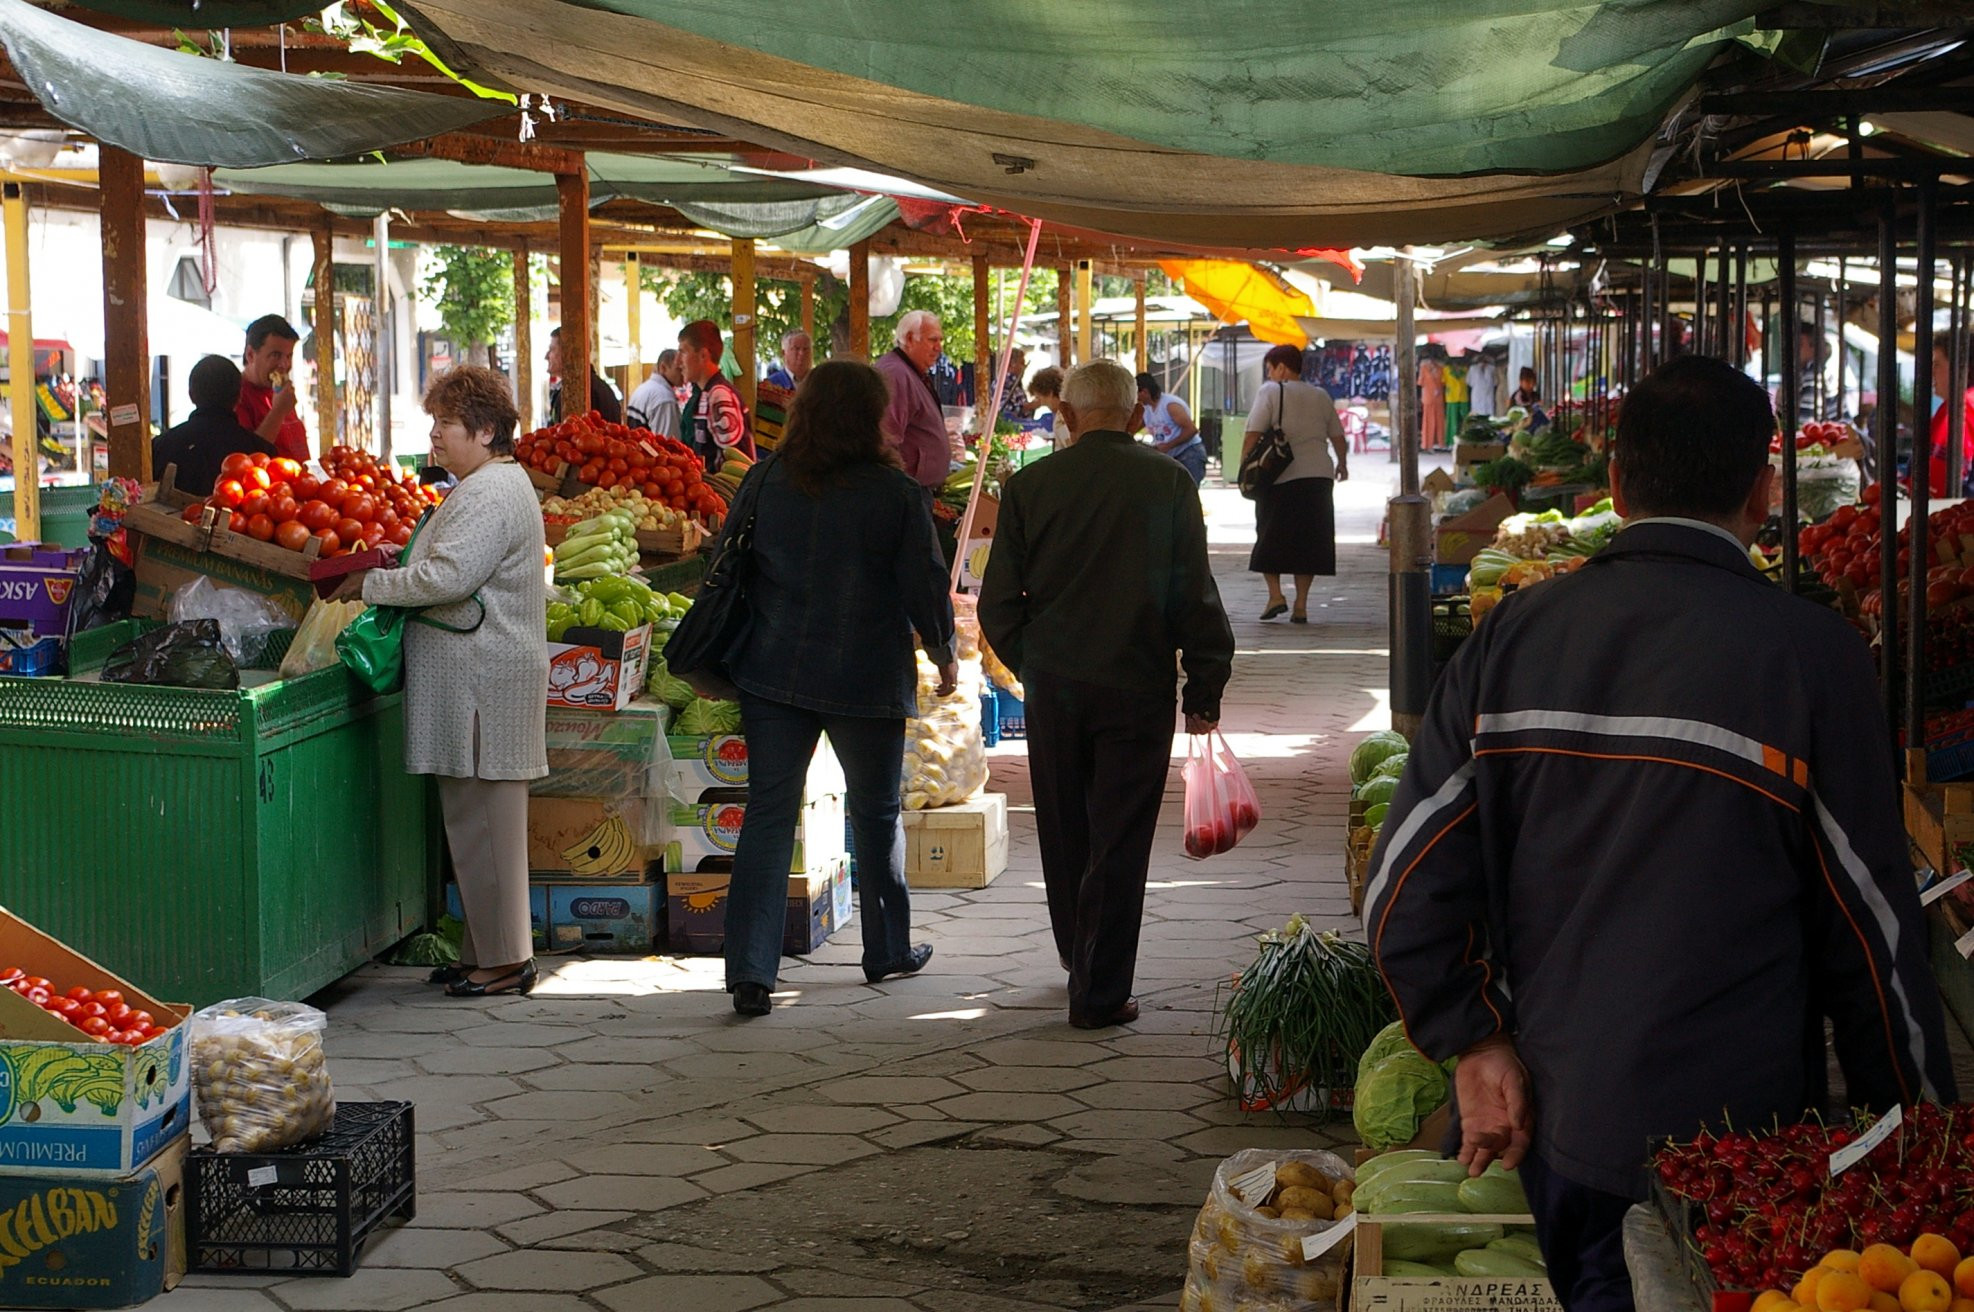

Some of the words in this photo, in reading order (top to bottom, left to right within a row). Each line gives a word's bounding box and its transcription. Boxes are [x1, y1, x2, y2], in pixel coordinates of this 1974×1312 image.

[0, 581, 39, 601] ASK
[0, 1141, 87, 1162] PREMIUM
[25, 1275, 112, 1287] ECUADOR
